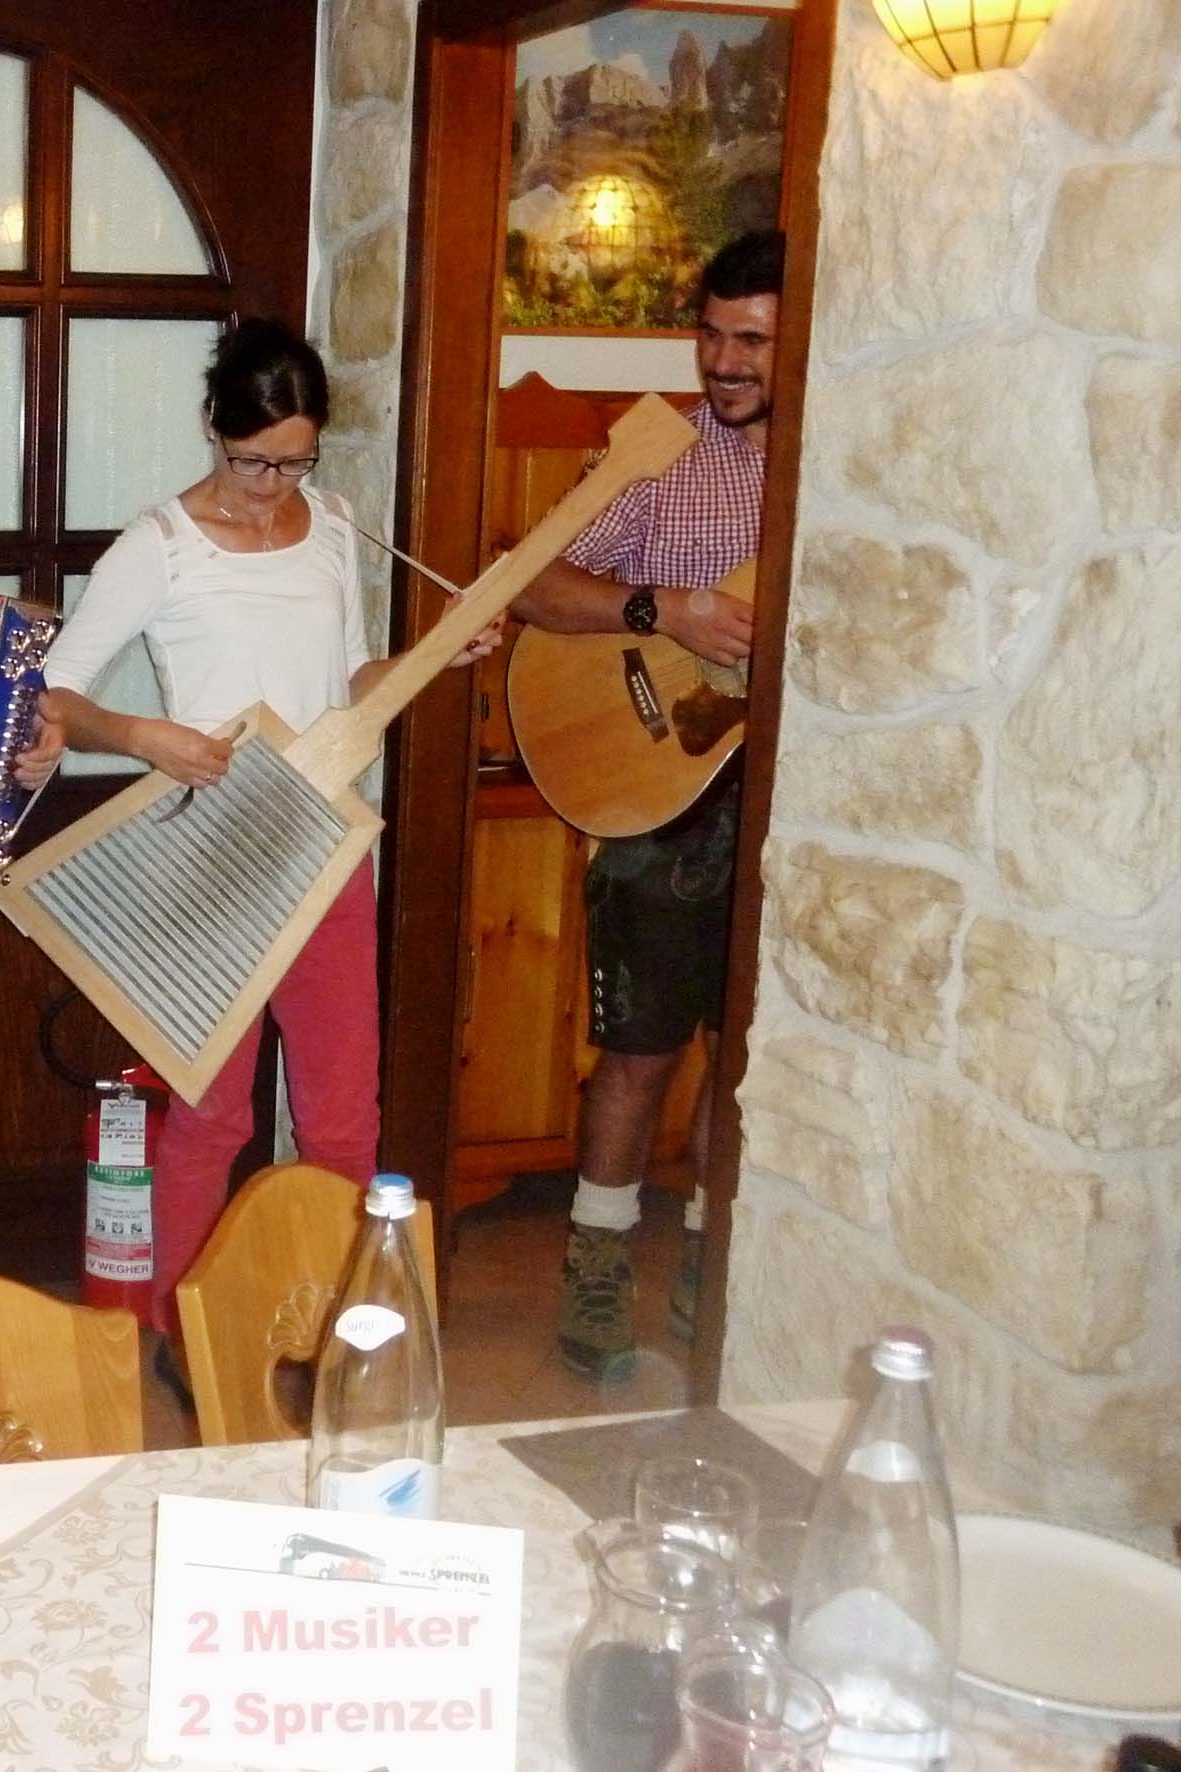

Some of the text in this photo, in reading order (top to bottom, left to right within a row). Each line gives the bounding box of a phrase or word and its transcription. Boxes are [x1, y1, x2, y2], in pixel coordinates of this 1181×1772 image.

[99, 1260, 149, 1274] WEGHER
[188, 1606, 479, 1653] 2 Musiker
[179, 1688, 493, 1745] 2 Sprenzel
